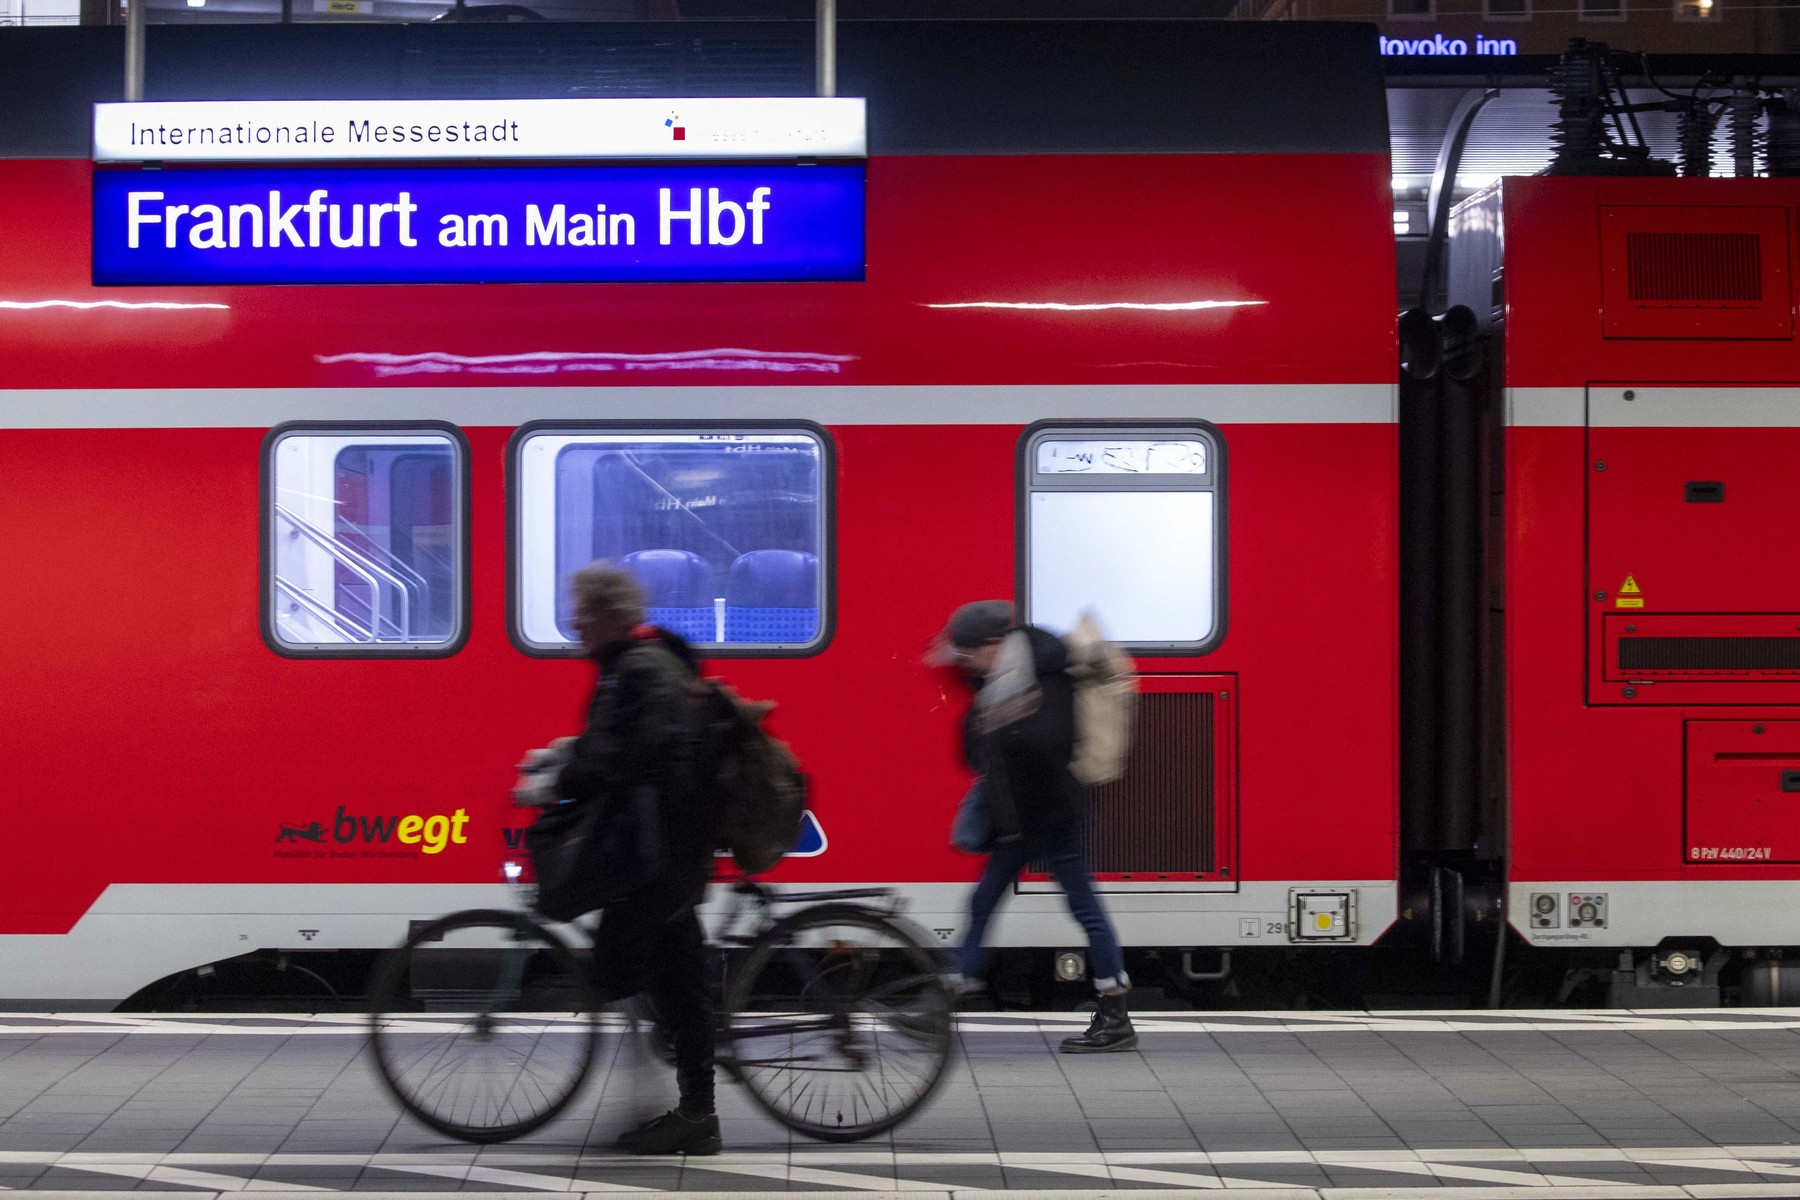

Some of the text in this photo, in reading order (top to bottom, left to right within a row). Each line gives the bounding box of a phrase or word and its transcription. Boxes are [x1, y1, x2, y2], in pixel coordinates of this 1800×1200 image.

[1476, 33, 1517, 56] inn
[131, 119, 519, 145] Internationale Messestadt
[127, 186, 771, 249] Frankfurt am Main Hbf
[332, 804, 470, 854] bwegt
[1691, 847, 1700, 859] 8
